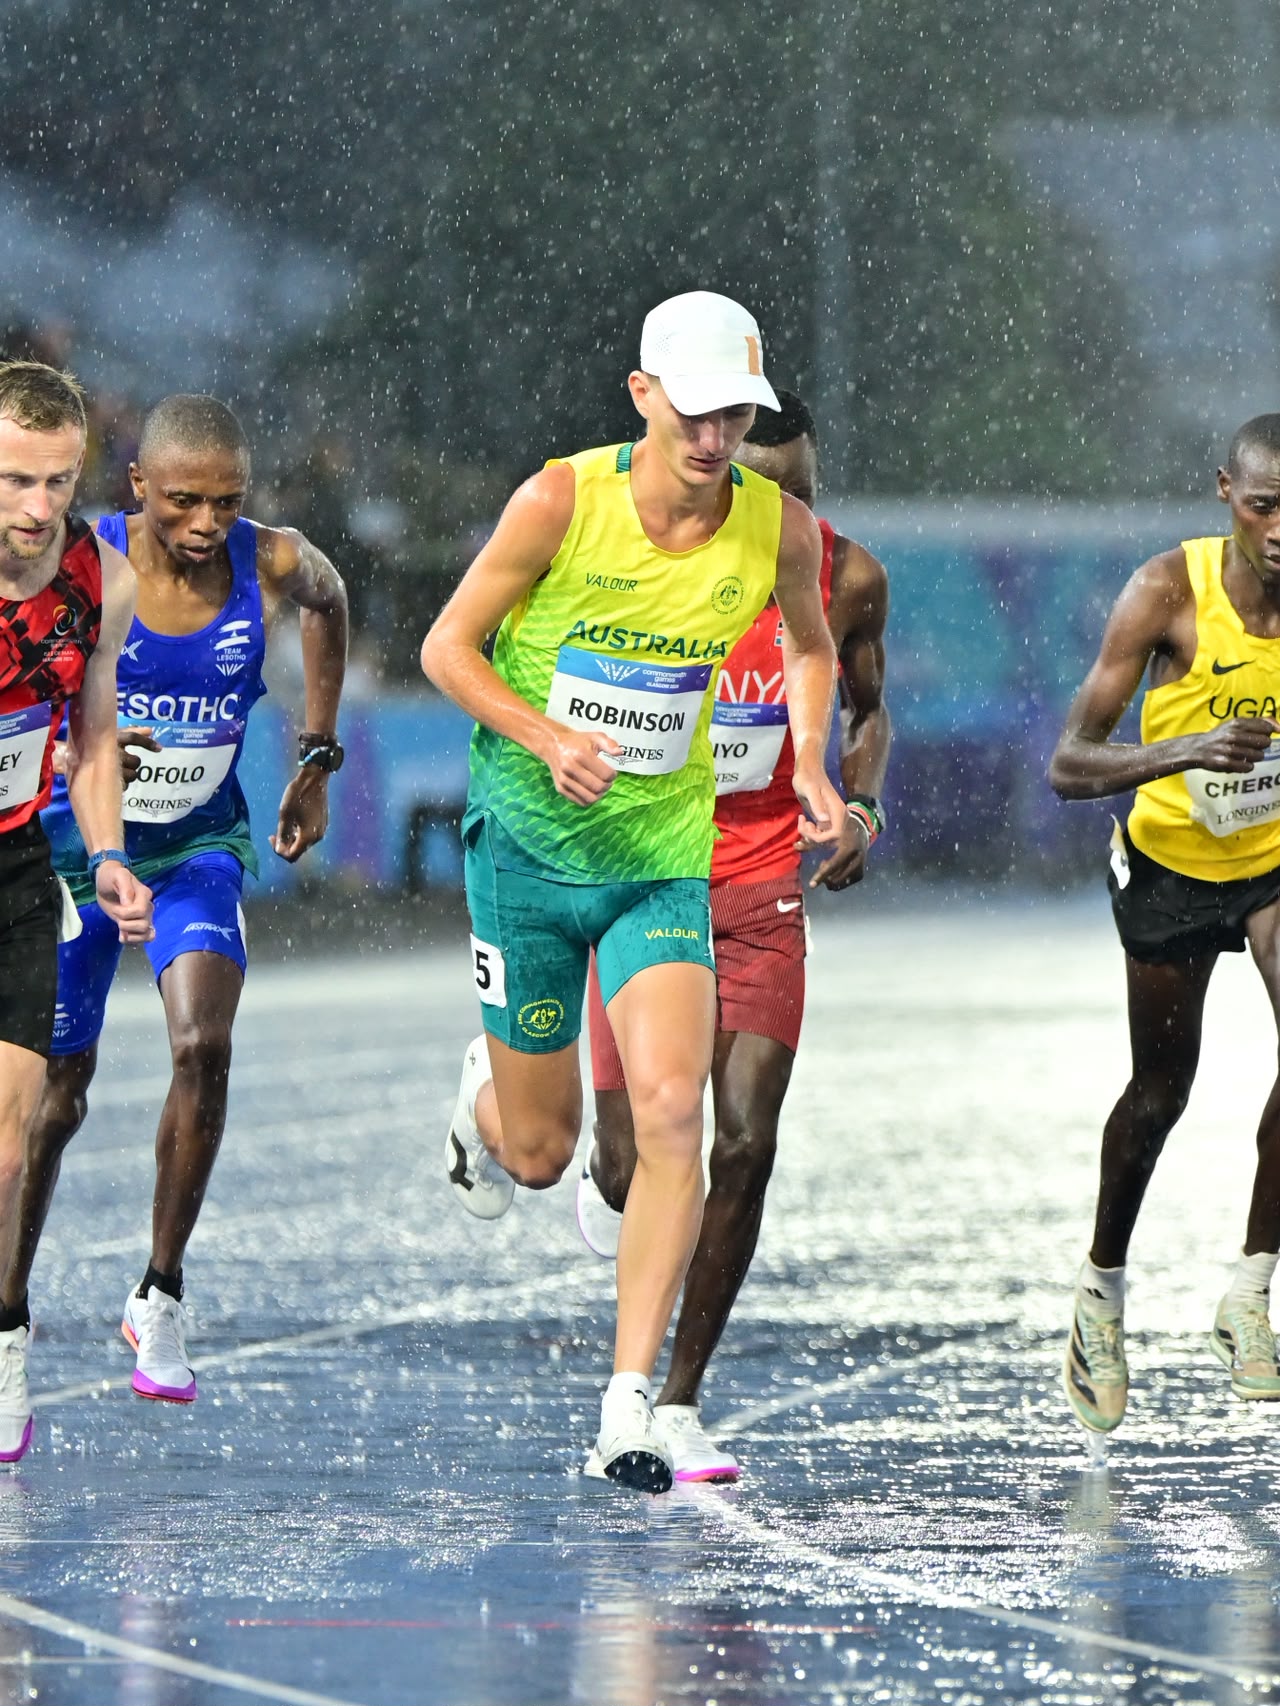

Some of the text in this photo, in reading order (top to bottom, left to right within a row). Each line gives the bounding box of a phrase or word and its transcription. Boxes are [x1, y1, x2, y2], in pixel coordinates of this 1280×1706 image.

[586, 573, 638, 592] VALOUR
[566, 620, 728, 659] AUSTRALIA
[642, 669, 687, 678] commonwealth
[117, 692, 239, 723] ESOTHO
[568, 697, 685, 732] ROBINSON
[137, 765, 205, 784] OFOLO
[123, 797, 192, 810] ONGINES
[645, 928, 699, 940] VALOUR
[476, 950, 491, 990] 5
[521, 1026, 550, 1038] GLASGOW
